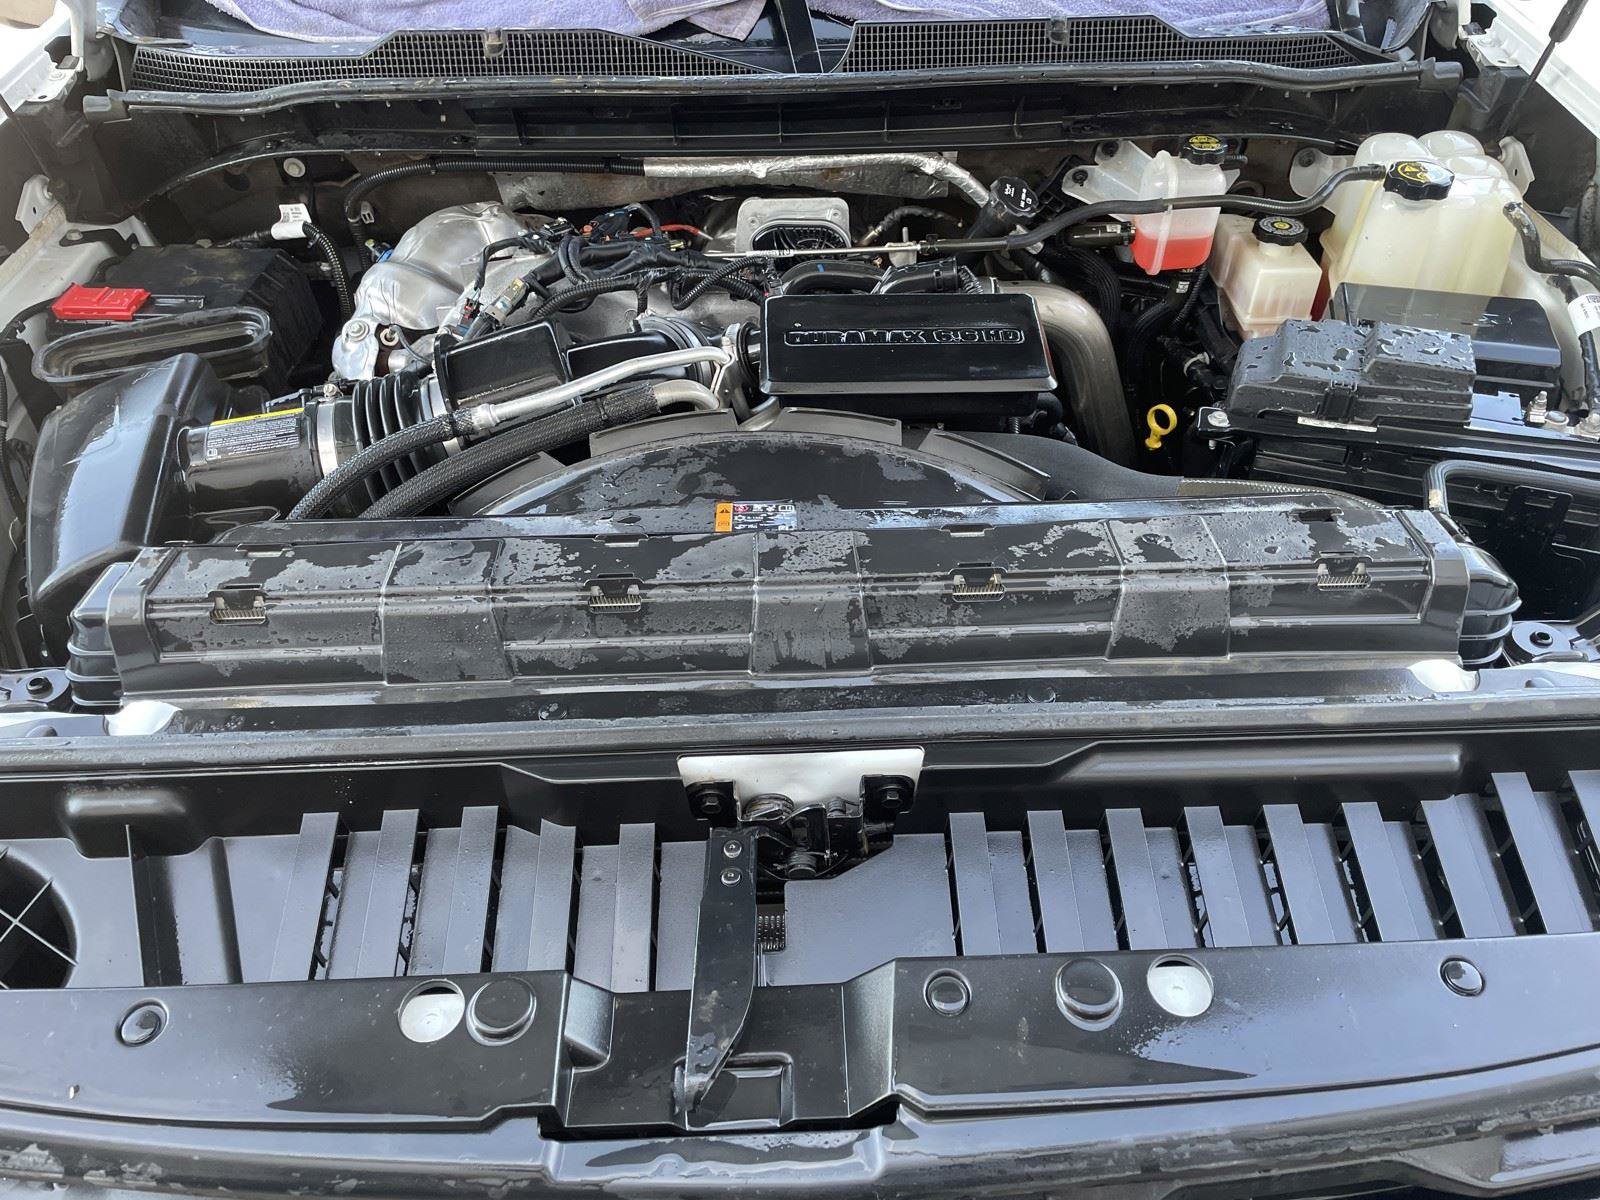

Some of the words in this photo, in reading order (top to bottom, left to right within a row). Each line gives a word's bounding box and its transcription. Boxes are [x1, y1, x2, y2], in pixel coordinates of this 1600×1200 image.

[787, 329, 926, 344] DURAMAX
[932, 329, 979, 344] 6.6
[982, 329, 1022, 344] HD
